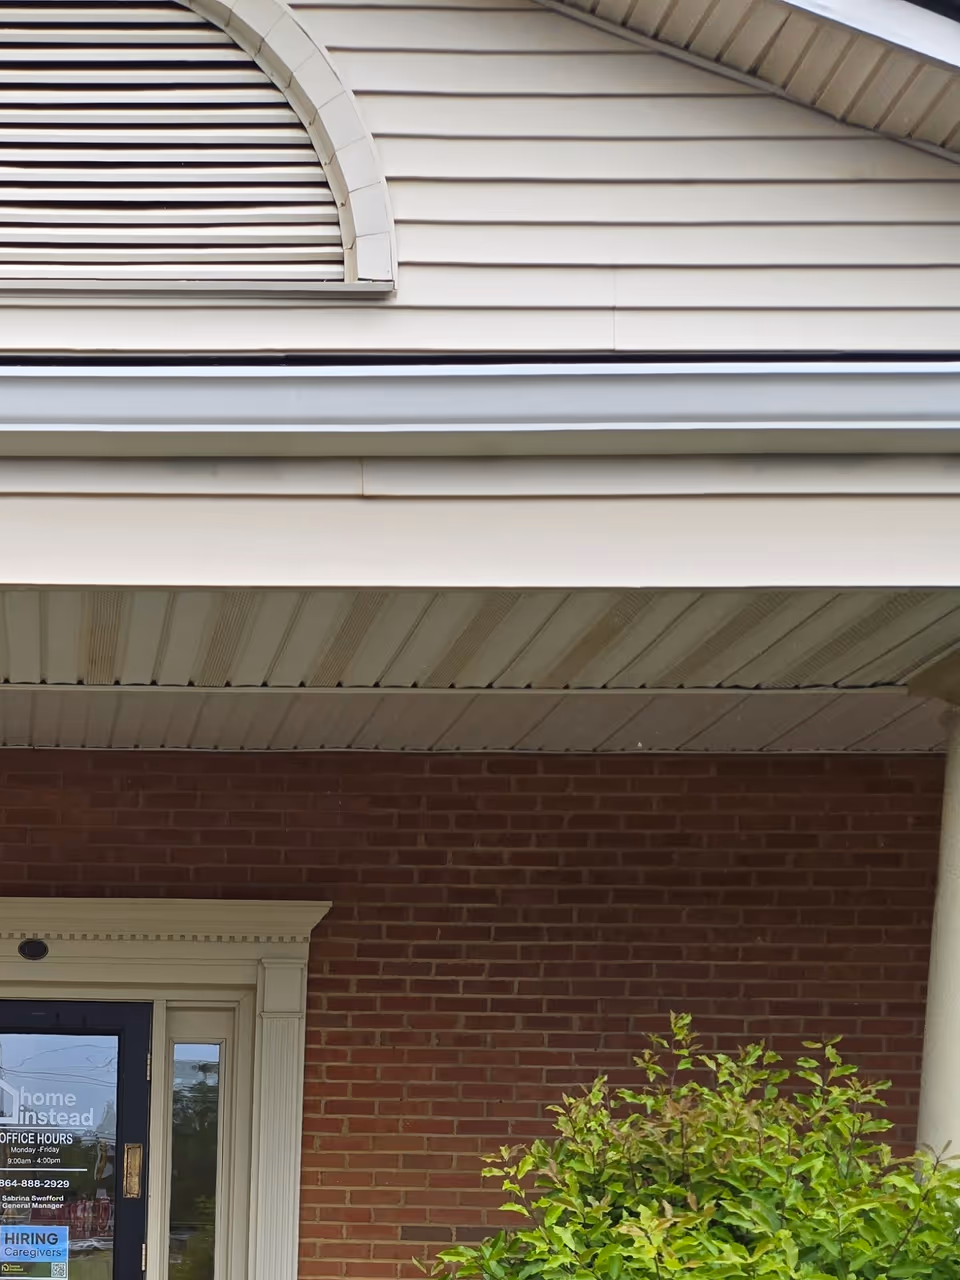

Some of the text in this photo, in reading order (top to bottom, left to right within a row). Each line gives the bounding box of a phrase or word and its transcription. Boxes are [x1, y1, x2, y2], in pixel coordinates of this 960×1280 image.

[20, 1086, 77, 1106] home
[19, 1105, 94, 1126] instead
[37, 1132, 73, 1144] HOURS
[10, 1146, 36, 1154] Monday
[36, 1157, 61, 1165] 4:00pm
[31, 1202, 64, 1210] Manager
[4, 1232, 59, 1245] HIRING
[4, 1247, 62, 1258] Caregivers
